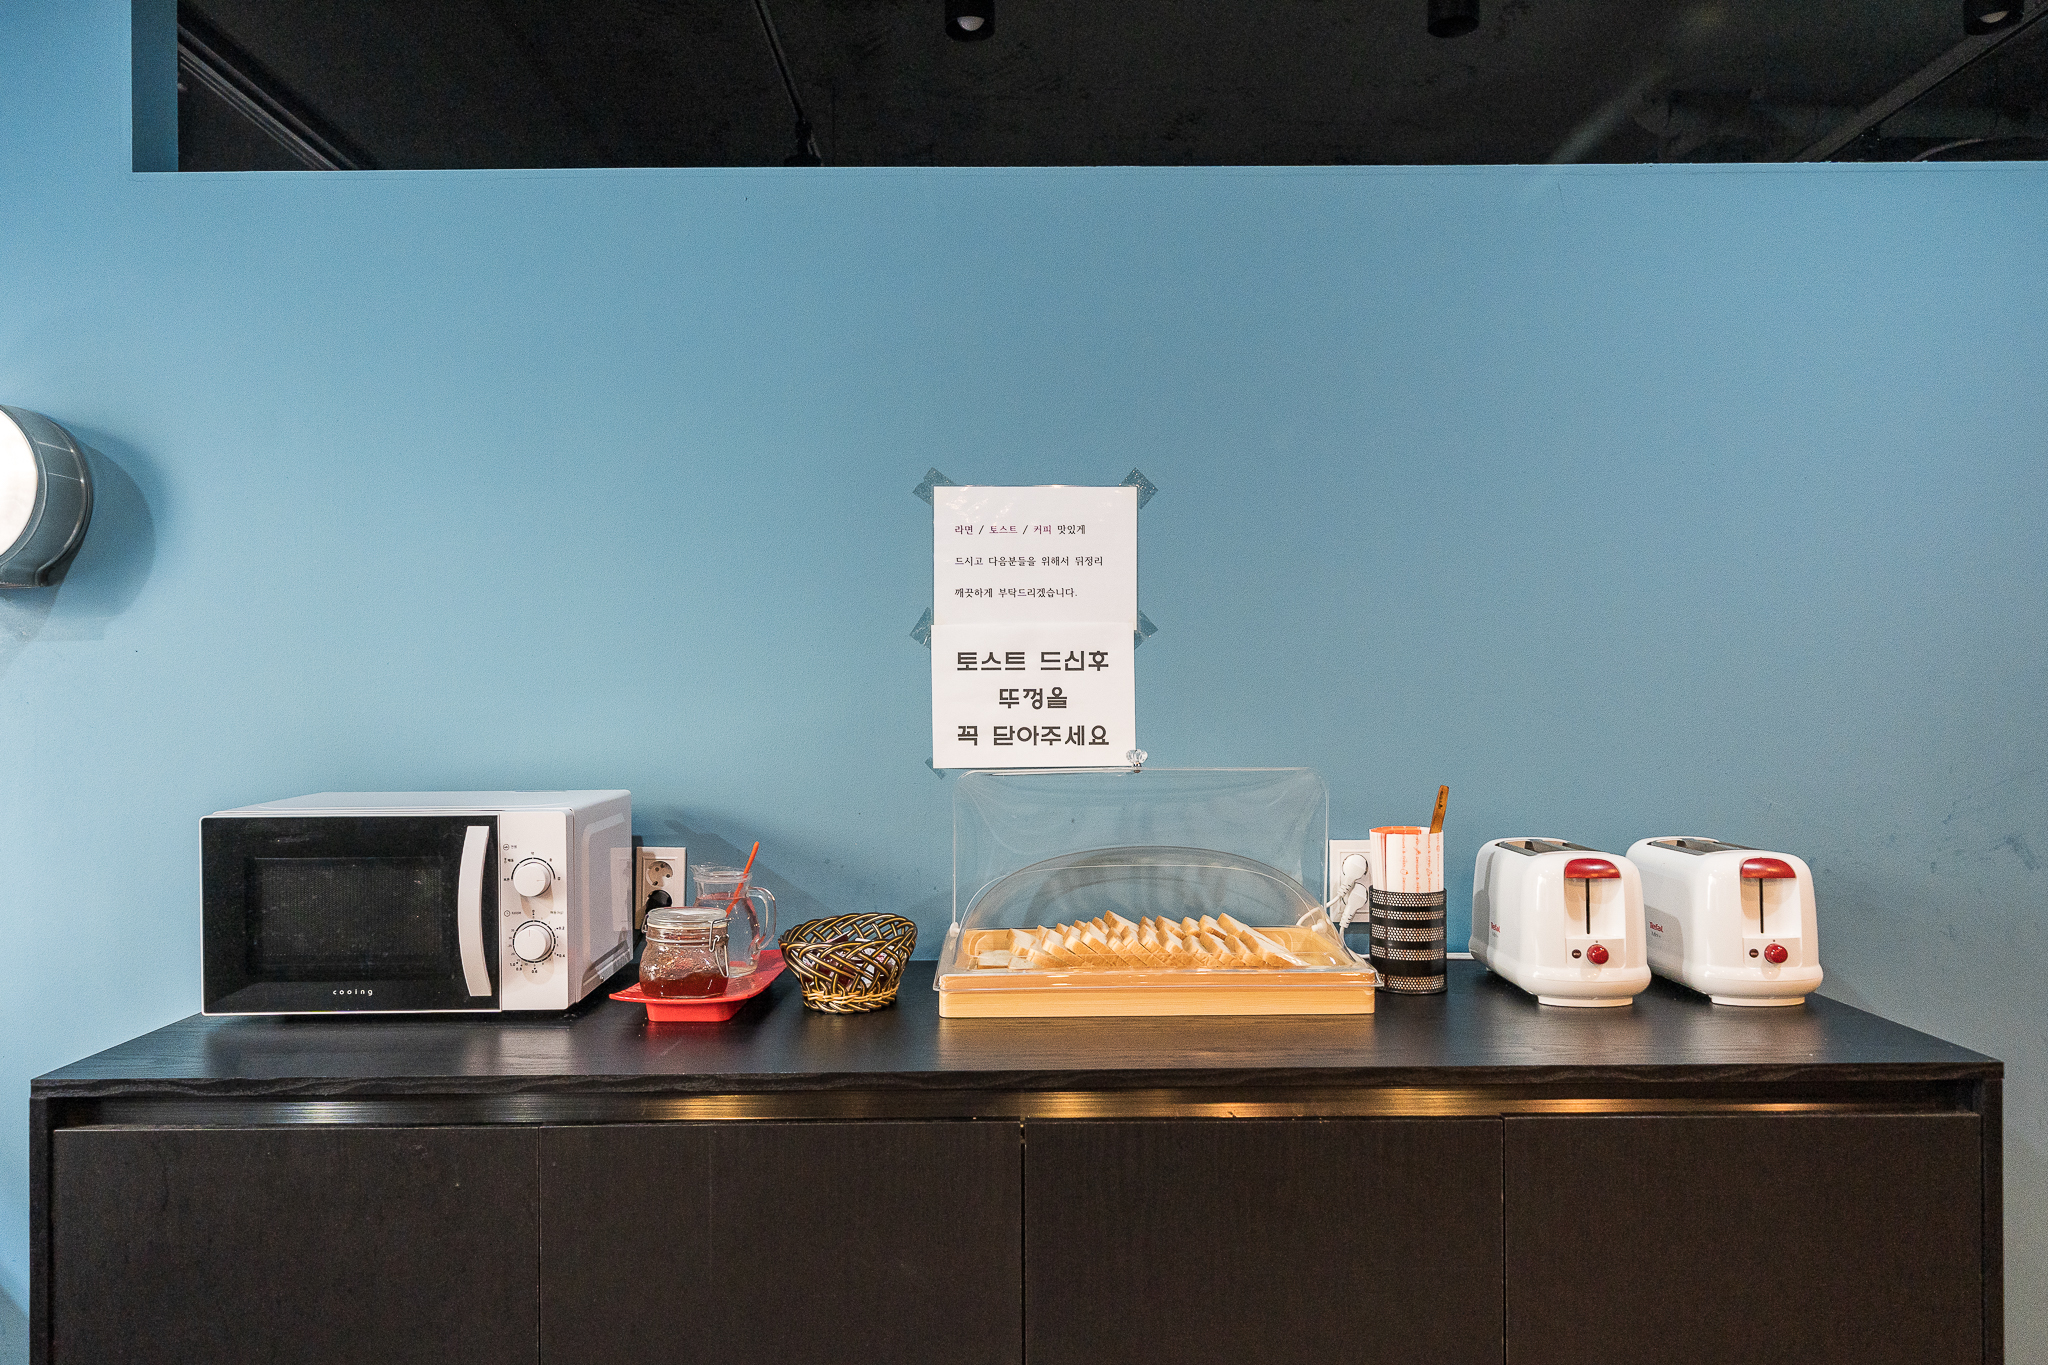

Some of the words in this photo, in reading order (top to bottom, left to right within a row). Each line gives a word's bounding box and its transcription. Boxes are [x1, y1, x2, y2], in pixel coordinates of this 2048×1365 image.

[954, 524, 973, 536] 라면
[988, 525, 1018, 535] 토스트
[1033, 524, 1052, 535] 커피
[1057, 524, 1086, 535] 맛있게
[954, 556, 984, 567] 드시고
[988, 556, 1037, 567] 다음분들을
[1041, 556, 1069, 567] 위해서
[1074, 556, 1103, 567] 뒤정리
[954, 587, 993, 599] 깨끗하게
[998, 587, 1078, 599] 부탁드리겠습니다.
[956, 651, 1026, 672] 토스트
[1040, 650, 1110, 672] 드신후
[998, 686, 1068, 711] 뚜껑을
[957, 725, 979, 747] 꼭
[993, 725, 1110, 747] 닫아주세요
